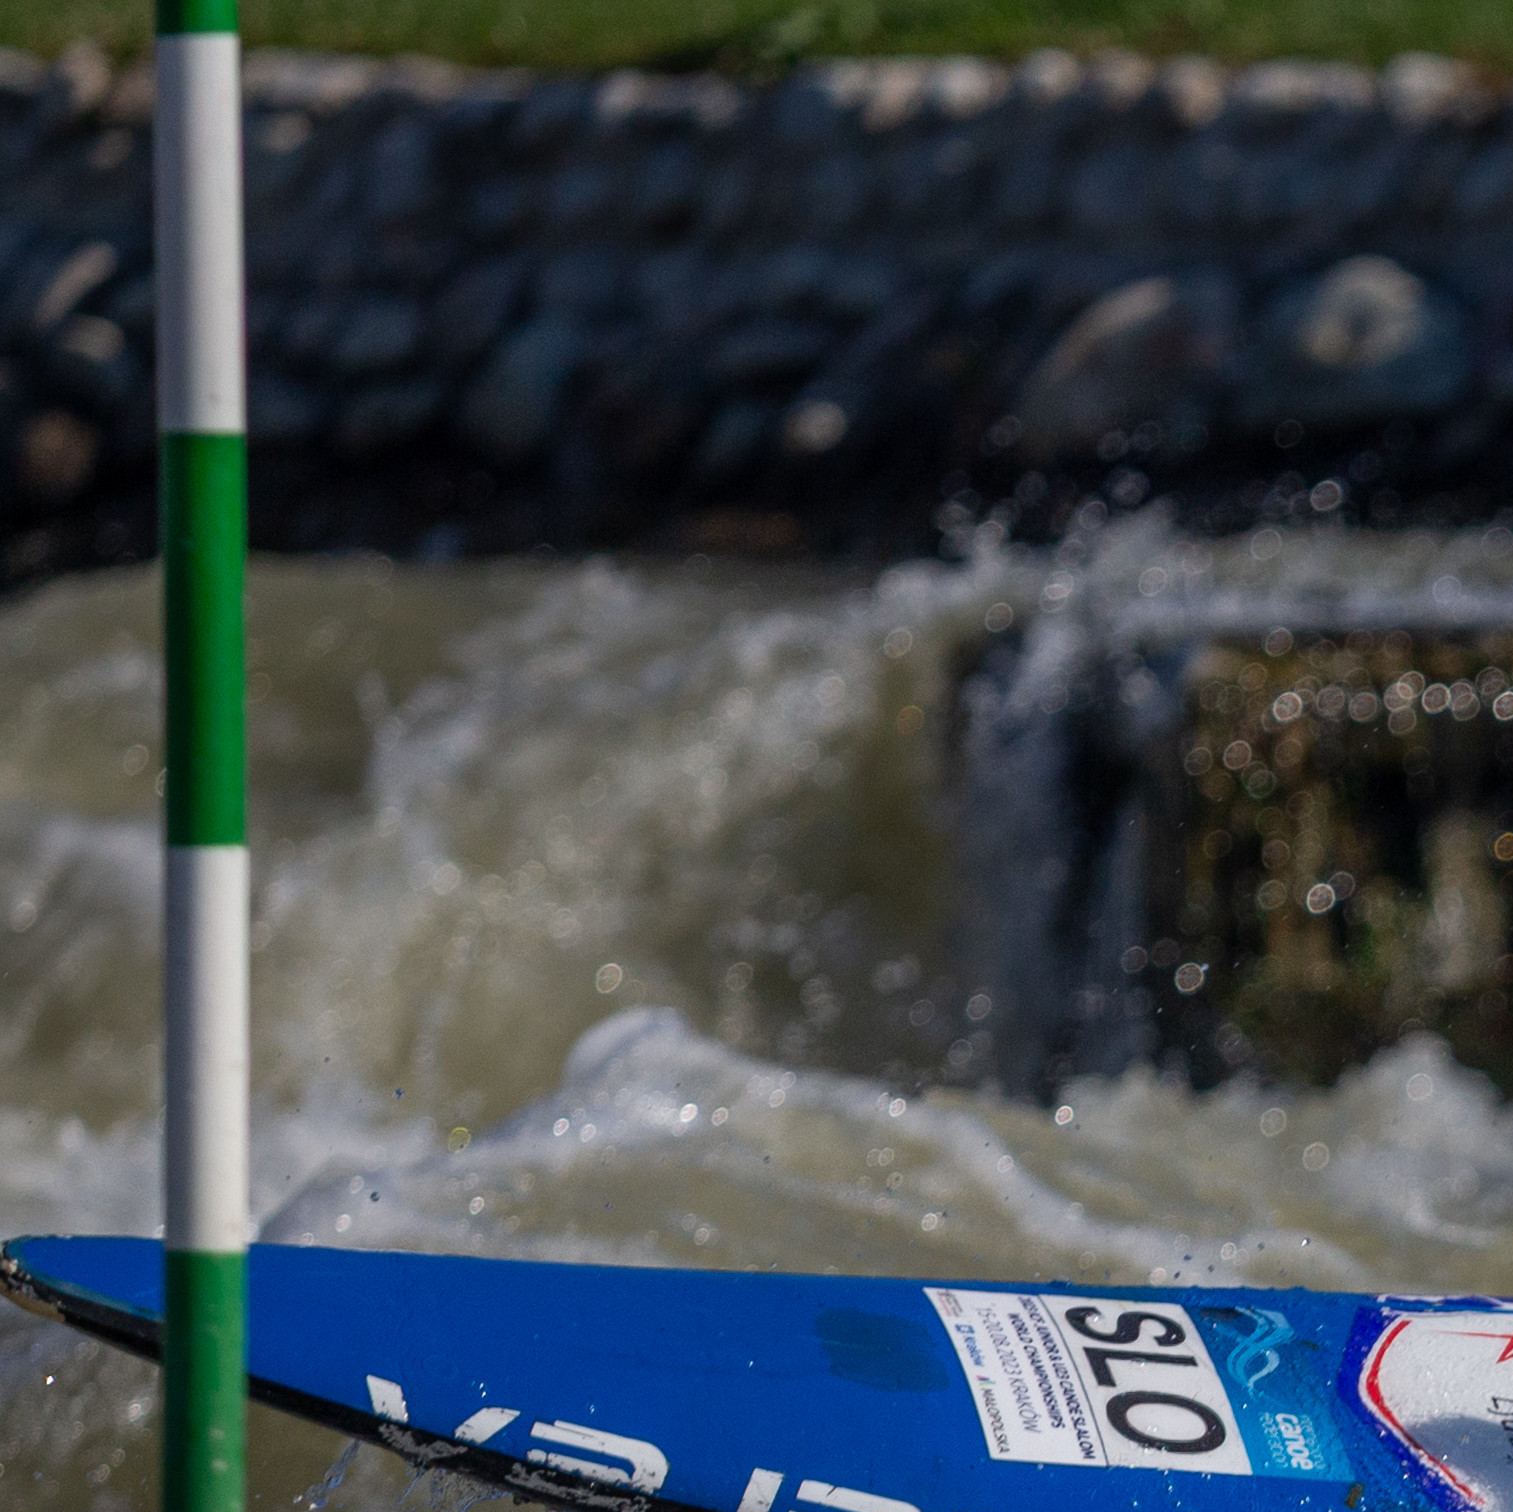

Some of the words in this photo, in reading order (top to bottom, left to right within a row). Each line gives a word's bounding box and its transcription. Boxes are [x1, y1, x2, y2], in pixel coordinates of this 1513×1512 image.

[1008, 1313, 1033, 1343] WORLD
[1022, 1345, 1066, 1428] CHAMPIONSHIPS
[1008, 1377, 1042, 1433] KRAKÓW
[1035, 1323, 1060, 1354] JUNIOR
[1059, 1380, 1083, 1415] CANOE
[1071, 1416, 1097, 1459] SLALOM
[1065, 1306, 1226, 1453] SLO
[1275, 1413, 1313, 1470] canoe
